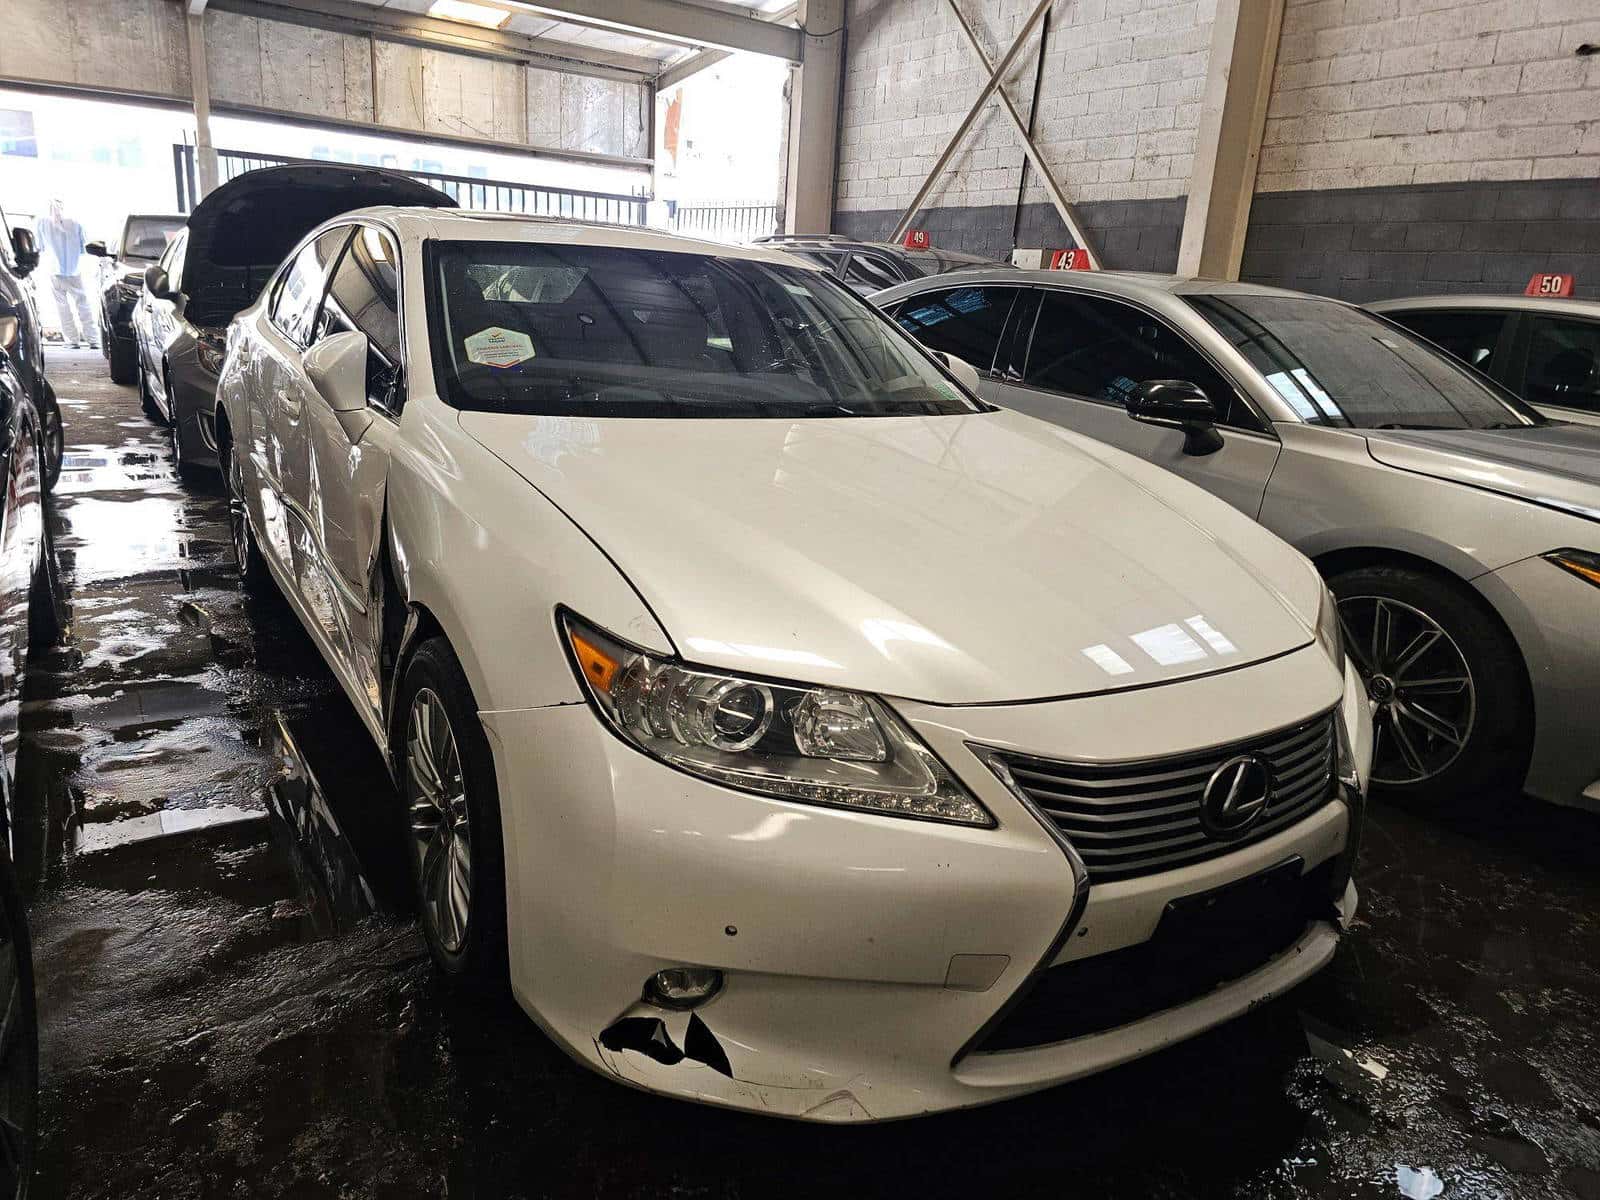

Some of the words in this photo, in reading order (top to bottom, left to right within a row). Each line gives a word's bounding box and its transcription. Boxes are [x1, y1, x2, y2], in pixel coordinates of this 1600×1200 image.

[913, 231, 924, 243] 49
[1057, 252, 1074, 270] 43
[1541, 275, 1562, 293] 50
